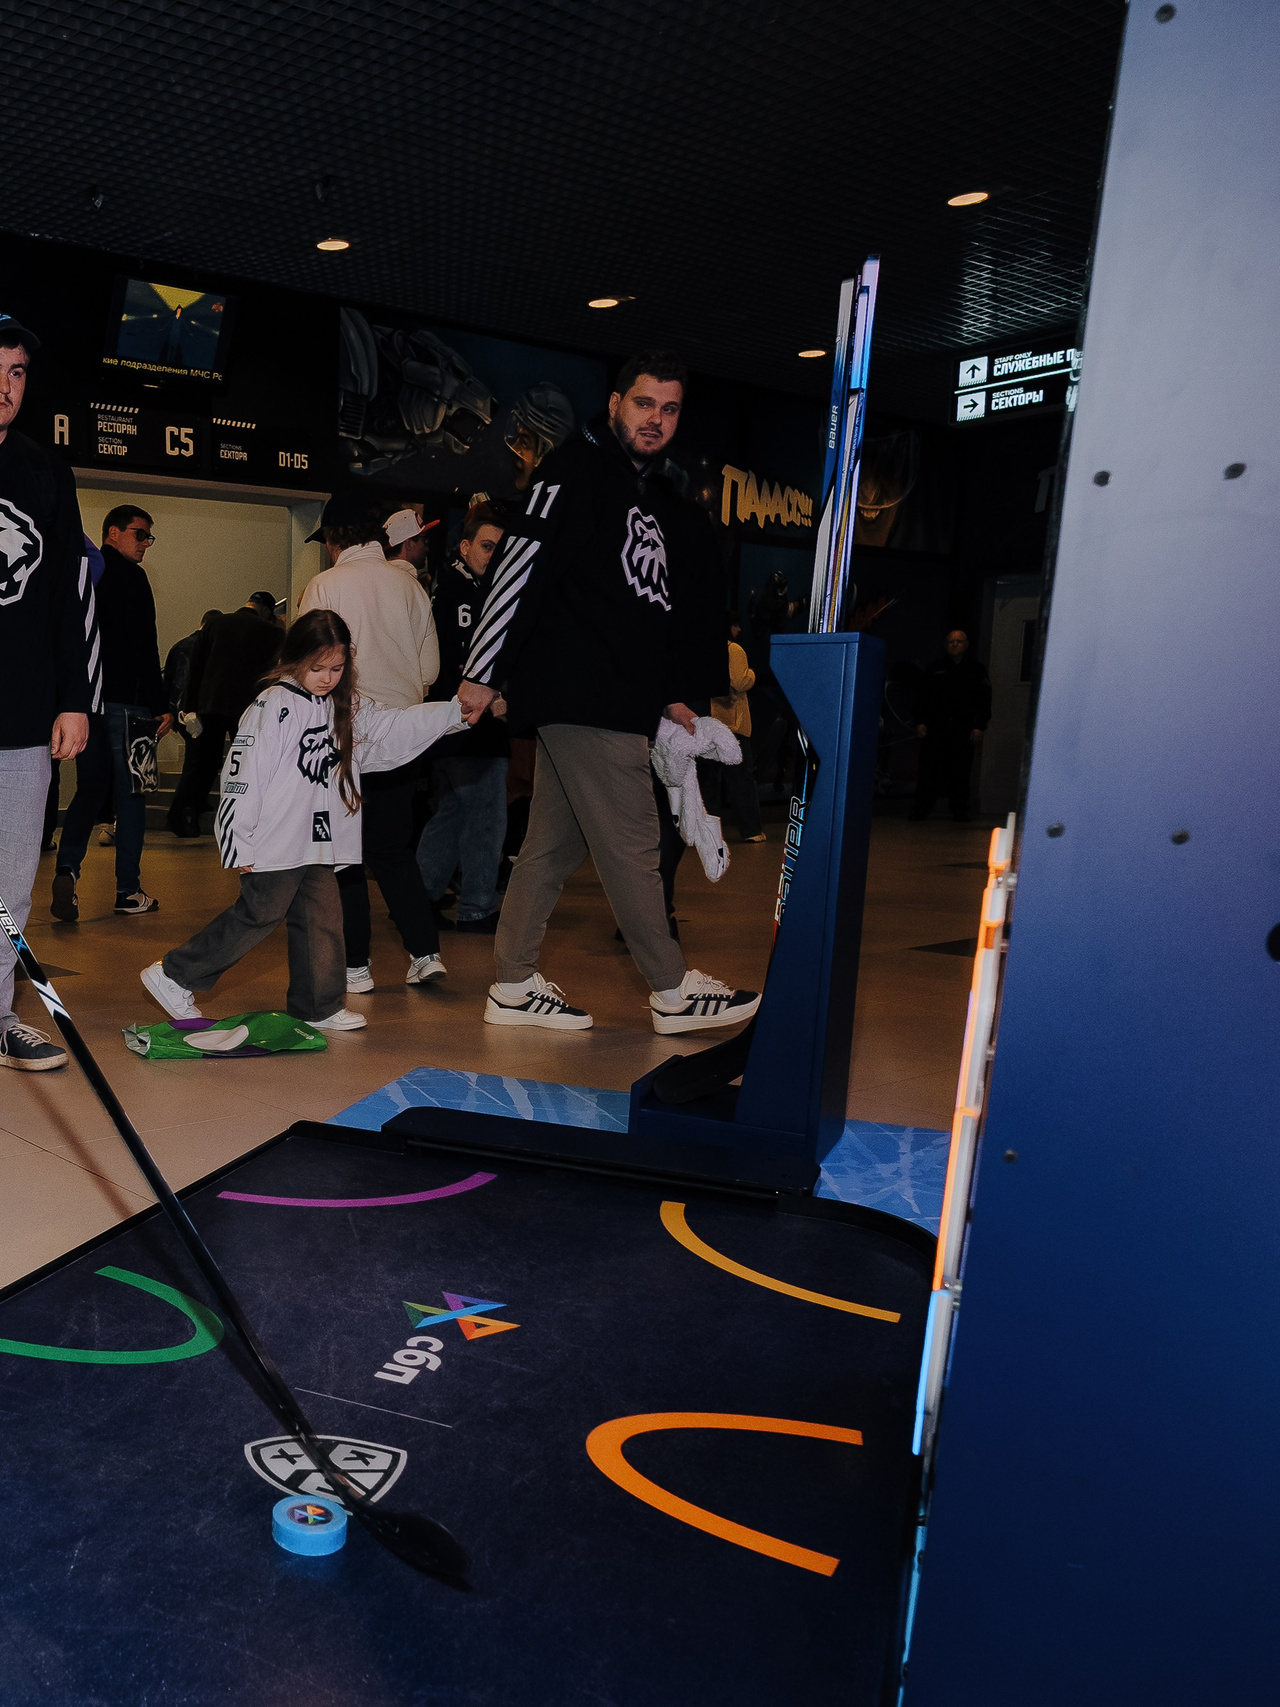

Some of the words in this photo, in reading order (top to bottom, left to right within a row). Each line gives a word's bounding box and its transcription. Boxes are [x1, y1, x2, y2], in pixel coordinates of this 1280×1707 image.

[993, 350, 1065, 377] СЛУЖЕБНЫЕ
[994, 355, 1014, 365] STAFF
[1014, 351, 1033, 359] ONLY
[120, 359, 188, 376] подразделения
[190, 368, 211, 379] МЧС
[991, 389, 1044, 411] СЕКТОРЫ
[992, 387, 1024, 399] SECTIONS
[97, 413, 134, 424] RESTAURANT
[97, 421, 138, 436] РЕСТОРАН
[98, 436, 123, 445] SECTION
[220, 443, 242, 451] SECTIONS
[98, 443, 128, 456] СЕКТОР
[525, 481, 561, 519] 11
[458, 603, 472, 628] 6
[228, 750, 243, 777] 5
